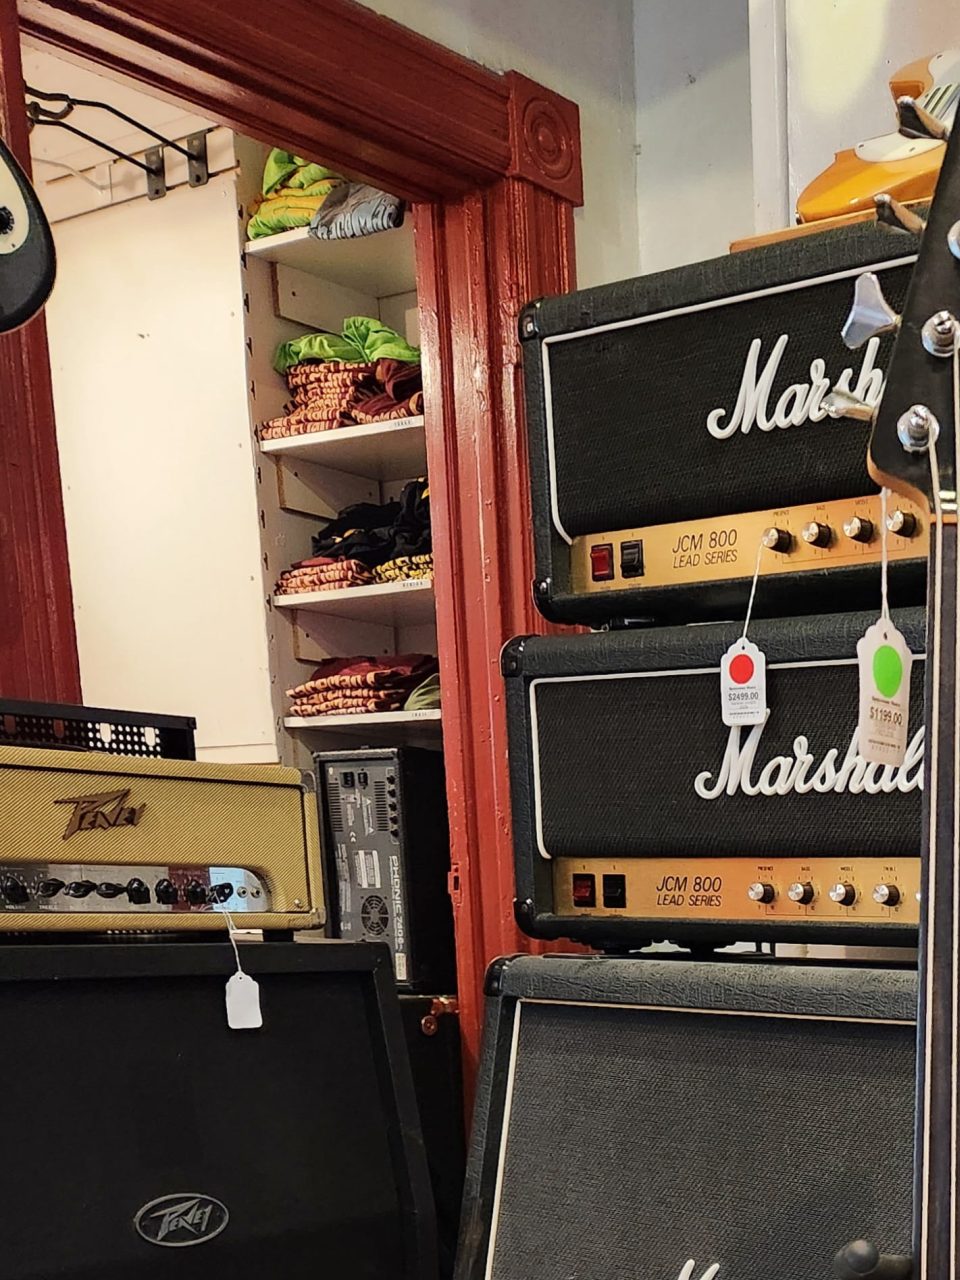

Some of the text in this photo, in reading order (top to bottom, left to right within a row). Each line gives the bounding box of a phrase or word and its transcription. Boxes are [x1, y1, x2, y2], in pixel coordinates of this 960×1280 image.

[707, 334, 887, 439] Marsh
[672, 529, 738, 553] JCM 800
[673, 550, 738, 568] LEAD SERIES
[728, 692, 759, 701] $2499.00
[870, 706, 903, 725] $1199.00
[694, 708, 925, 799] Marshal
[391, 855, 402, 914] PHONIC
[656, 876, 722, 893] JCM 800
[657, 895, 722, 906] LEAD SERIES
